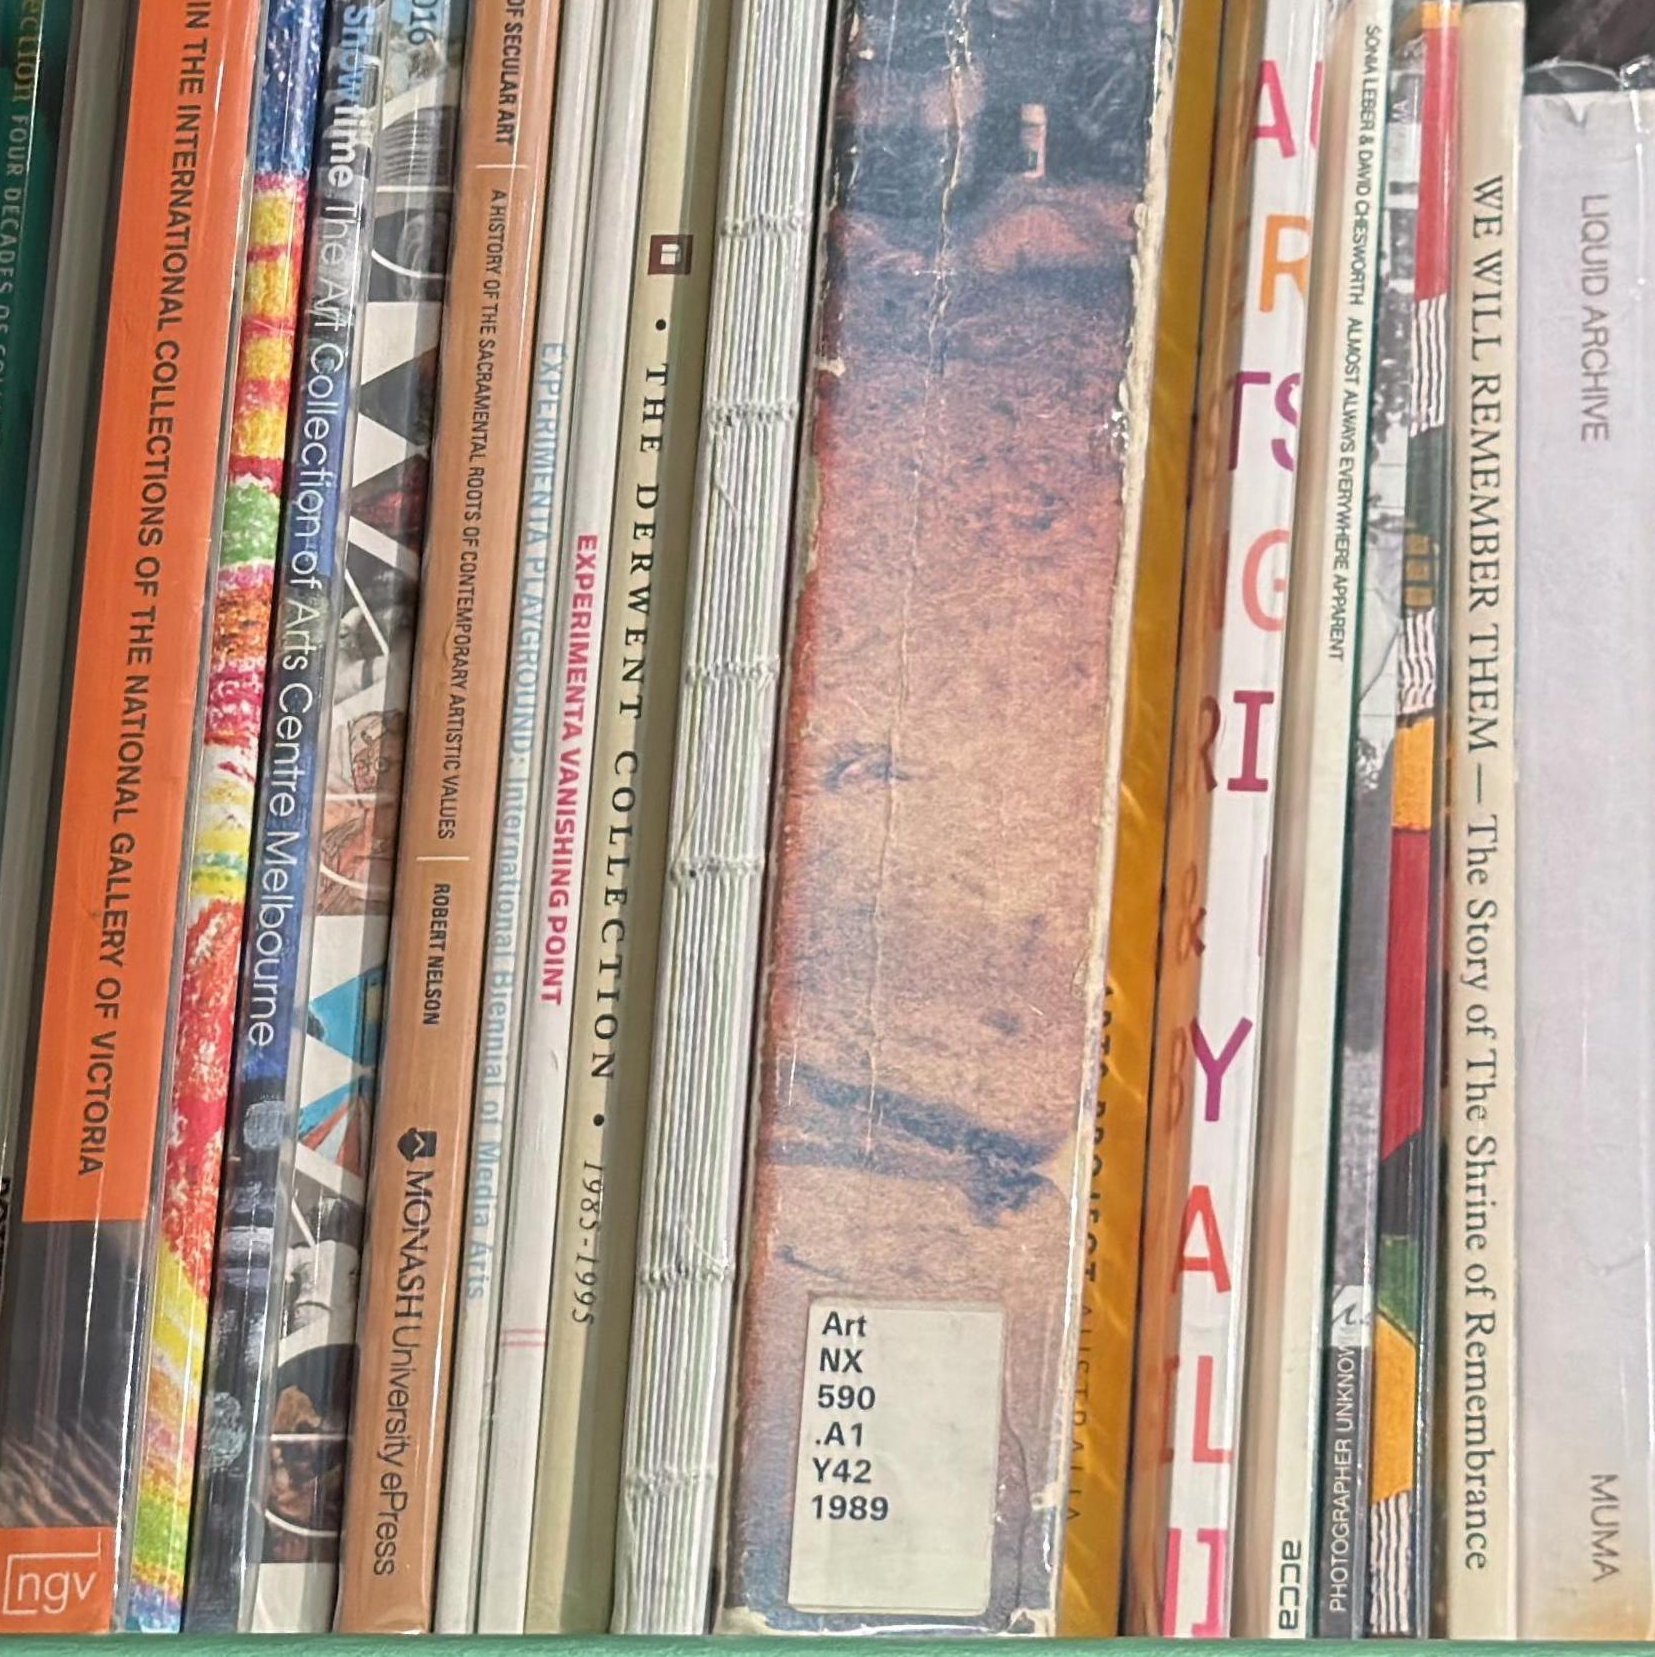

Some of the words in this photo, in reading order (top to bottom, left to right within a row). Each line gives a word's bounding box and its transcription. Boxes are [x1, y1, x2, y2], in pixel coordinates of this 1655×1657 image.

[181, 0, 213, 28] IN
[1359, 24, 1380, 72] SONIA
[175, 38, 210, 94] THE
[325, 5, 378, 187] Showtime
[496, 21, 525, 104] SECULAR
[0, 115, 29, 174] FOUR
[493, 110, 519, 144] ART
[153, 104, 204, 330] INTERNATIONAL
[318, 199, 360, 264] The
[1472, 175, 1504, 238] WE
[1581, 194, 1610, 297] LIQUID
[1471, 248, 1504, 361] WILL
[637, 364, 669, 454] THE
[1581, 306, 1610, 441] ARCHIVE
[134, 340, 182, 546] COLLECTIONS
[294, 342, 347, 540] Collection
[522, 342, 568, 543] EXPERIMENTA
[1469, 373, 1503, 612] REMEMBER
[129, 557, 163, 598] OF
[448, 551, 479, 689] CONTEMPORARY
[616, 484, 660, 722] DERWENT
[123, 607, 158, 664] THE
[282, 601, 323, 671] Arts
[559, 535, 599, 740] EXPERIMENTA
[442, 695, 467, 770] ARTISTIC
[1468, 623, 1502, 751] THEM
[108, 676, 152, 823] NATIONAL
[269, 684, 315, 817] Centre
[436, 775, 460, 838] VALUES
[546, 748, 583, 908] VANISHING
[1467, 816, 1501, 885] The
[95, 833, 138, 966] GALLERY
[490, 776, 533, 962] International
[249, 830, 301, 1048] Melbourne
[426, 883, 451, 951] ROBERT
[538, 916, 570, 1006] POINT
[589, 751, 640, 1080] COLLECTION
[1461, 899, 1501, 992] Story
[90, 978, 125, 1020] OF
[422, 955, 447, 1025] NELSON
[480, 971, 517, 1090] Biennial
[76, 1030, 120, 1176] VICTORIA
[1466, 1049, 1500, 1121] The
[470, 1143, 504, 1225] Media
[1465, 1135, 1500, 1251] Shrine
[391, 1169, 434, 1317] MONASH
[464, 1242, 496, 1299] Arts
[820, 1347, 864, 1373] NX
[821, 1311, 868, 1337] Art
[372, 1326, 422, 1464] University
[816, 1421, 865, 1448] .A1
[818, 1384, 876, 1411] 590
[1463, 1311, 1499, 1568] Remembrance
[812, 1457, 873, 1484] Y42
[812, 1495, 889, 1521] 1989
[372, 1472, 412, 1575] ePress
[1590, 1474, 1622, 1581] MUMA
[1278, 1540, 1302, 1631] acca
